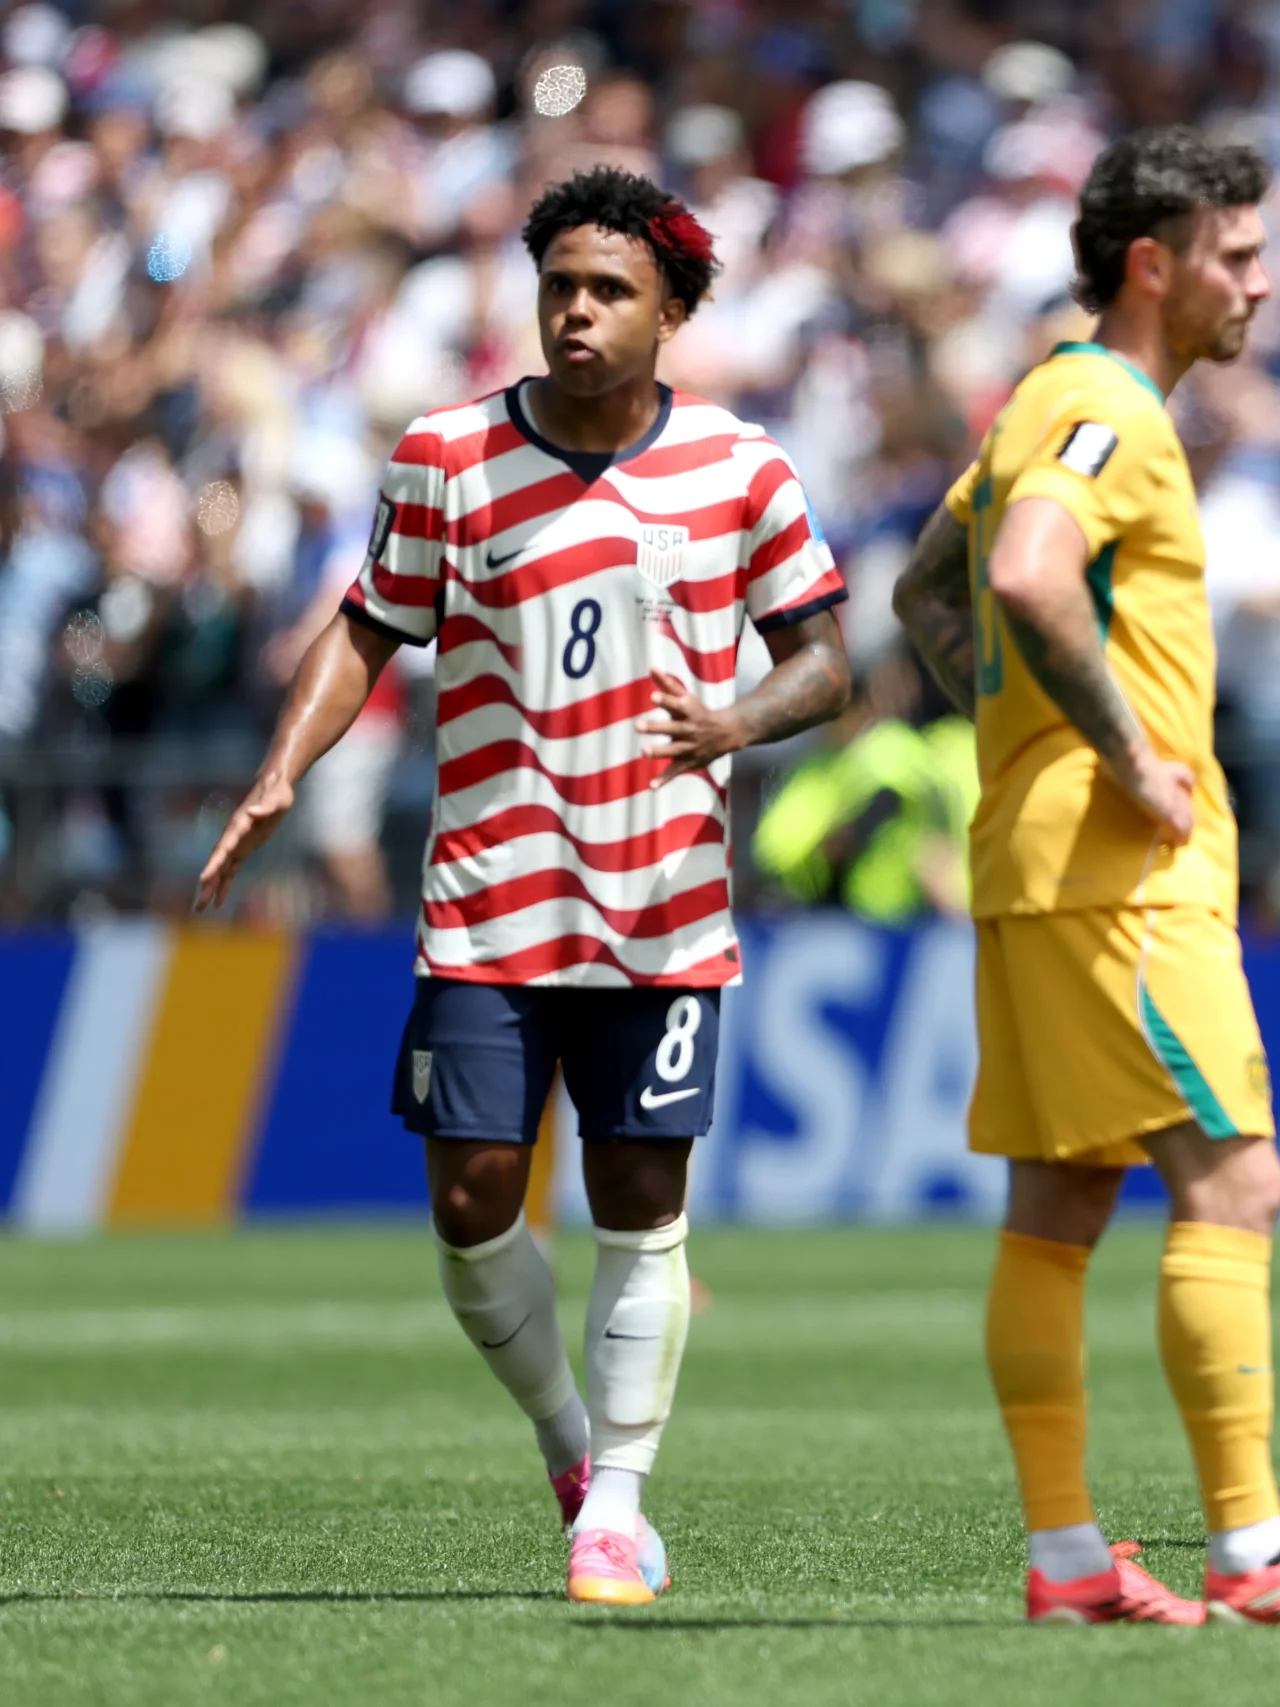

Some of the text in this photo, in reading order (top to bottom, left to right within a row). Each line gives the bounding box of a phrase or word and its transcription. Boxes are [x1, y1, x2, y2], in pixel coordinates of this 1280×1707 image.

[642, 529, 684, 552] USA
[562, 598, 603, 680] 8
[655, 994, 702, 1083] 8
